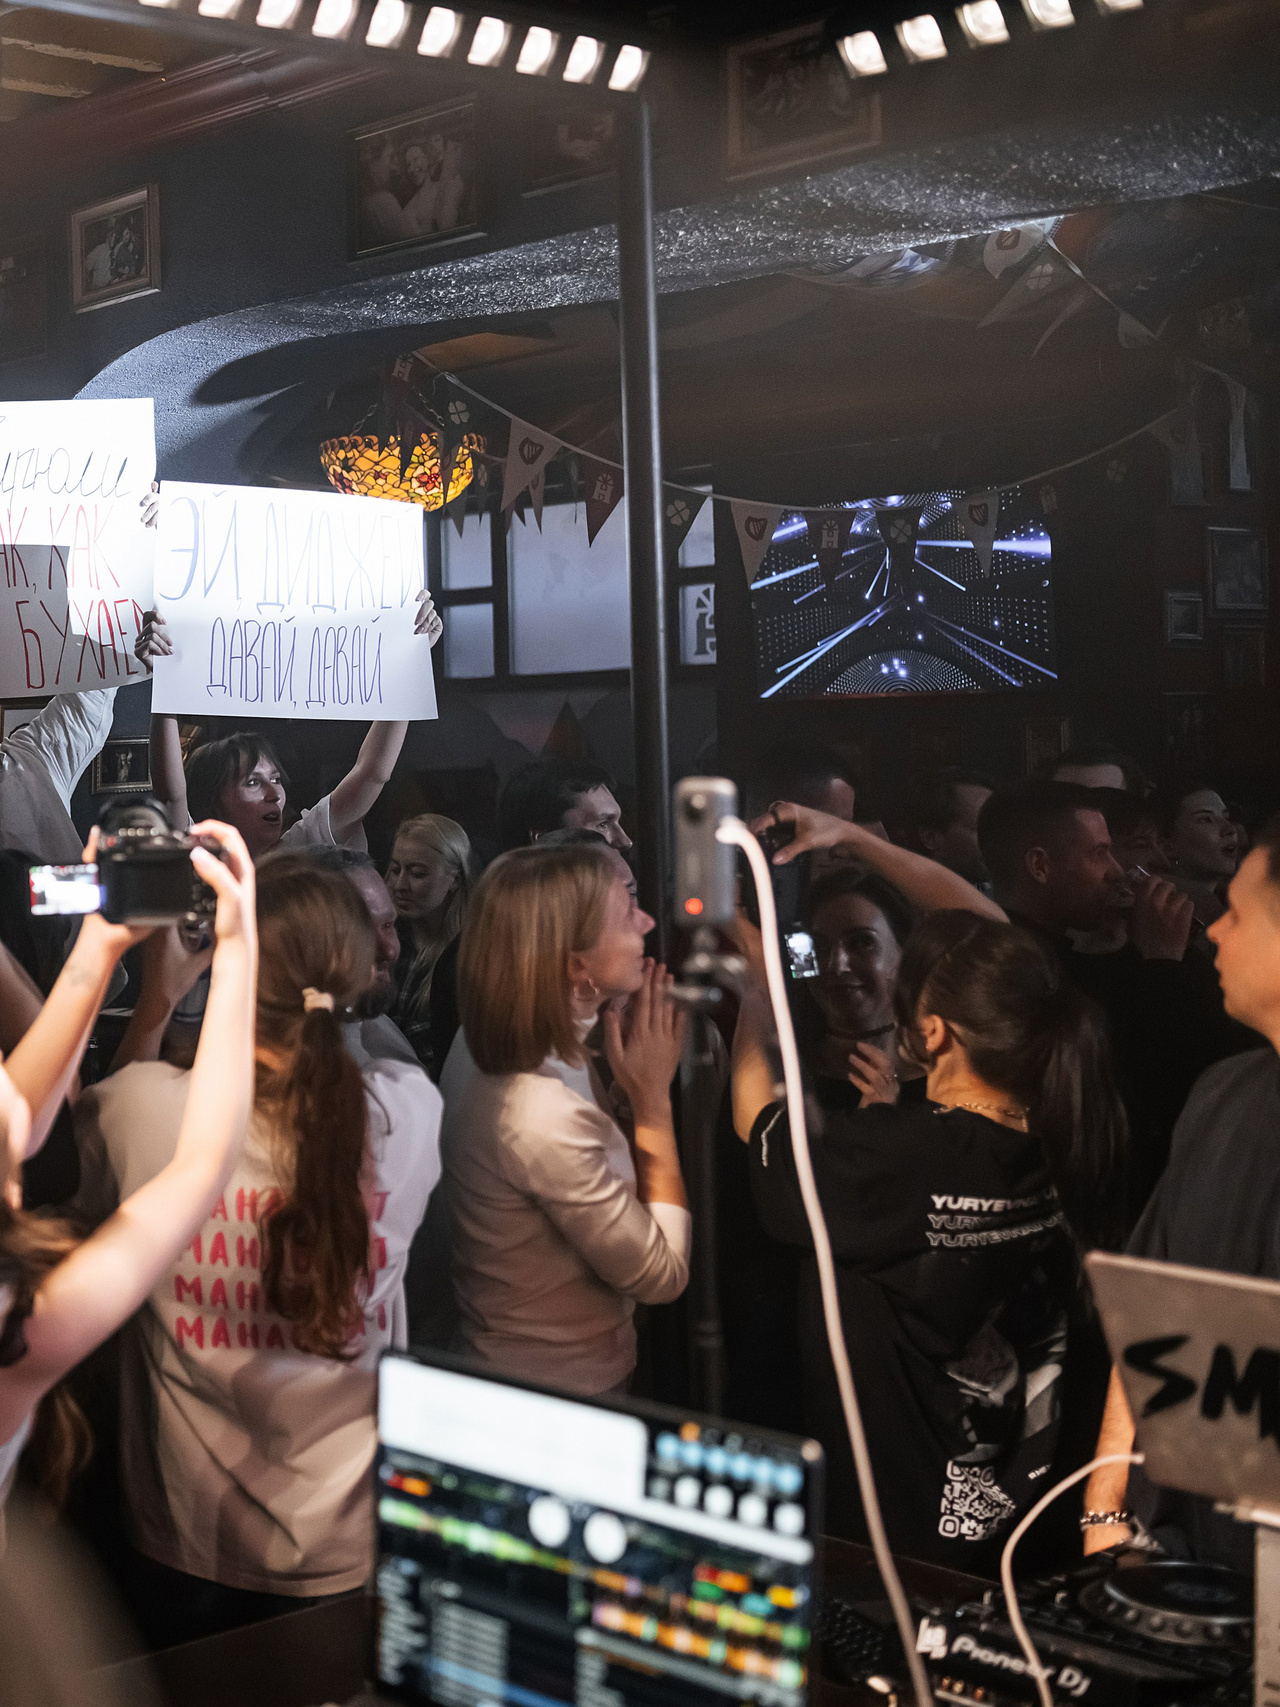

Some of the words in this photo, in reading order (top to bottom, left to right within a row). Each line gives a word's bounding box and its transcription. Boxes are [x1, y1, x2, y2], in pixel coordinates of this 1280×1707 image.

[49, 503, 121, 590] КАК
[159, 489, 243, 612] ЭЙ,
[206, 615, 298, 711] ДАВАЙ,
[305, 615, 383, 710] ДАВАЙ
[1123, 1333, 1280, 1453] SM
[950, 1633, 1058, 1680] Pioner
